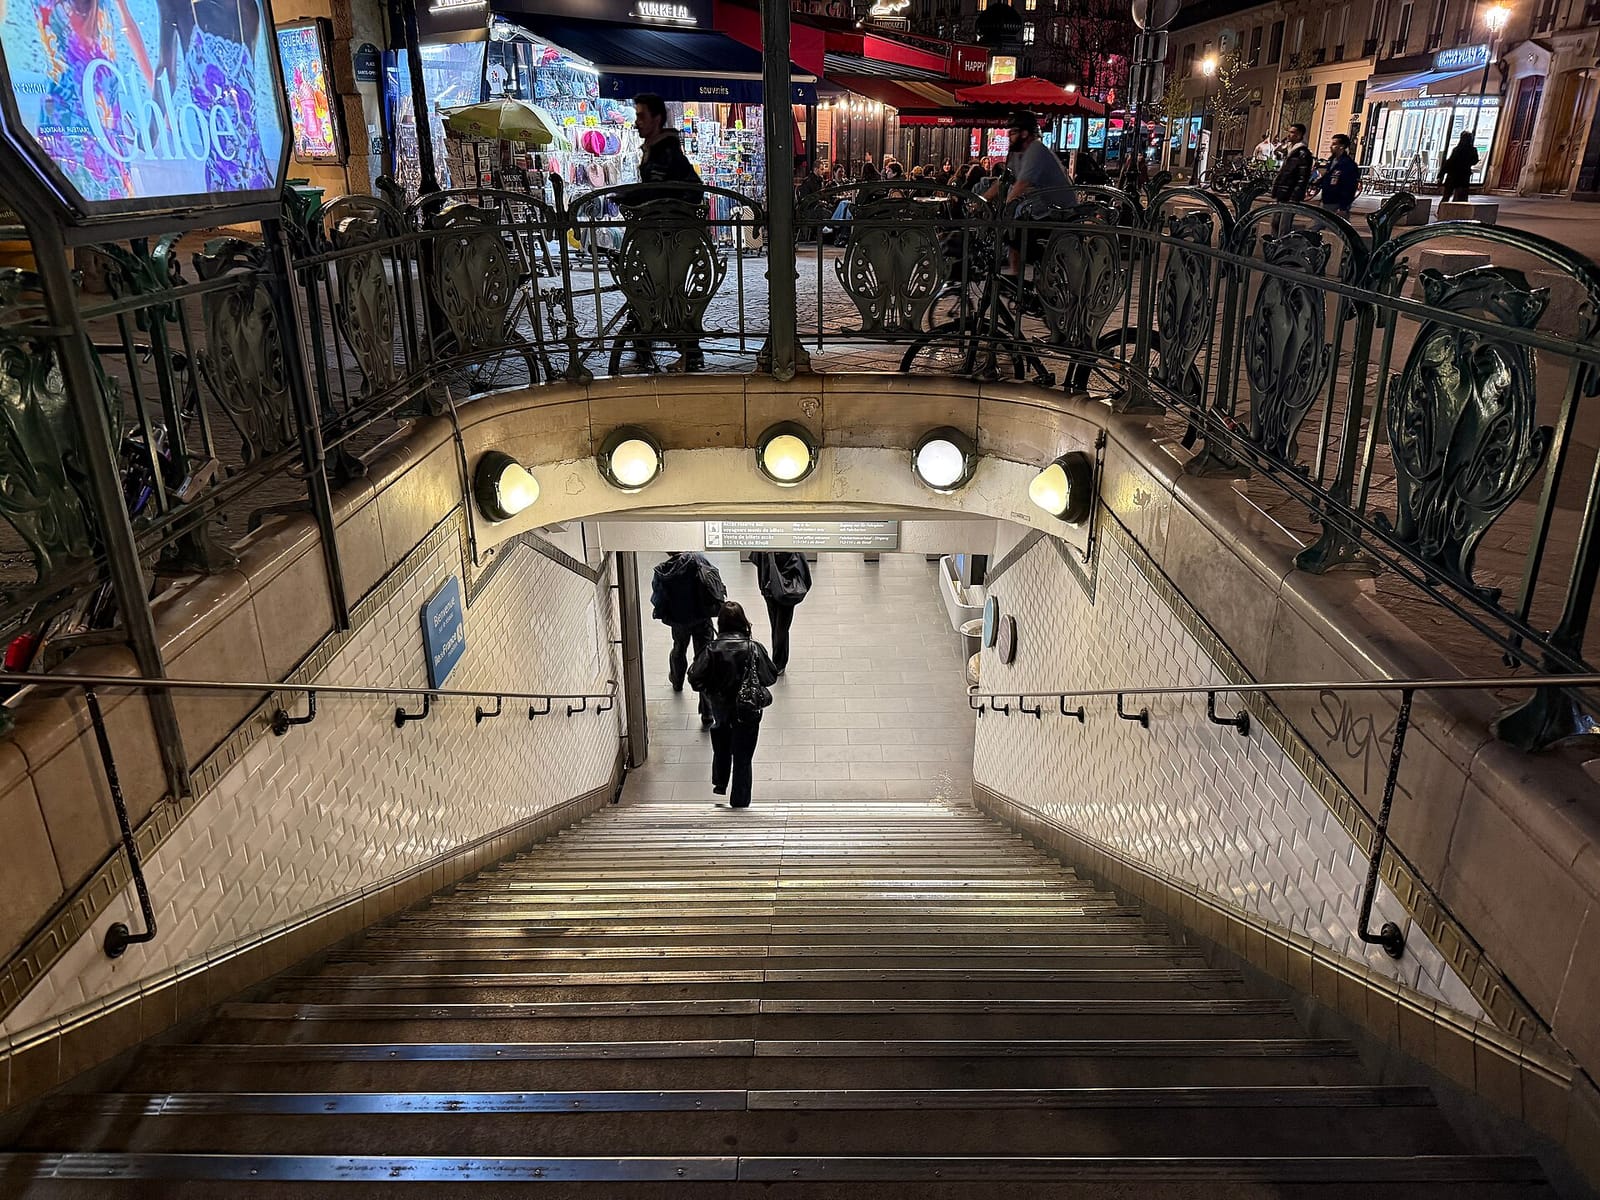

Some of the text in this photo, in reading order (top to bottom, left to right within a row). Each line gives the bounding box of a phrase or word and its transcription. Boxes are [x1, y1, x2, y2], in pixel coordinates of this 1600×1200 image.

[638, 1, 658, 16] YUN
[659, 3, 673, 17] KE
[281, 32, 315, 48] GUERLAIN
[965, 60, 986, 72] HAPPY
[613, 81, 619, 91] 2
[699, 85, 729, 96] souvenirs
[797, 88, 805, 97] 2
[502, 174, 523, 182] MUSIC
[433, 596, 456, 628] Bienvenue
